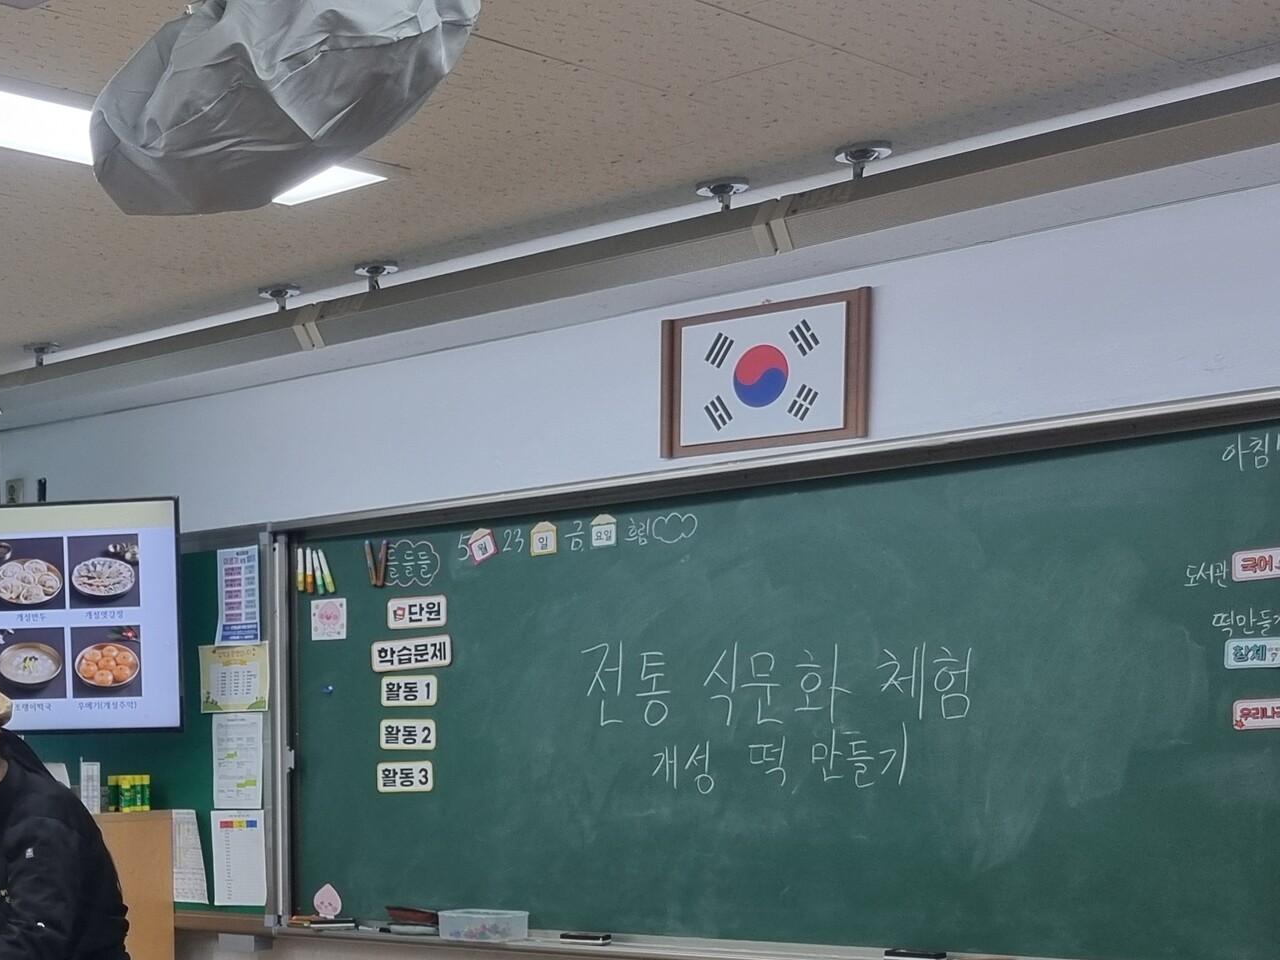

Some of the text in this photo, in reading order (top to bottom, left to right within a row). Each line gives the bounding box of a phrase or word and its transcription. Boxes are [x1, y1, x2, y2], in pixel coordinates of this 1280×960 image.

[477, 541, 488, 557] 월
[503, 528, 524, 552] 23
[538, 536, 548, 550] 일
[594, 529, 612, 541] 요일
[625, 517, 650, 546] 흐림
[1184, 560, 1230, 588] 도서관
[1240, 554, 1274, 574] 국어
[408, 602, 442, 623] 단원
[377, 641, 447, 666] 학습문제
[385, 681, 431, 701] 활동 1
[580, 640, 973, 727] 전통 식문화 체험
[384, 724, 432, 745] 활동 2
[652, 721, 908, 794] 개성 떡 만들기
[381, 767, 429, 788] 활동 3
